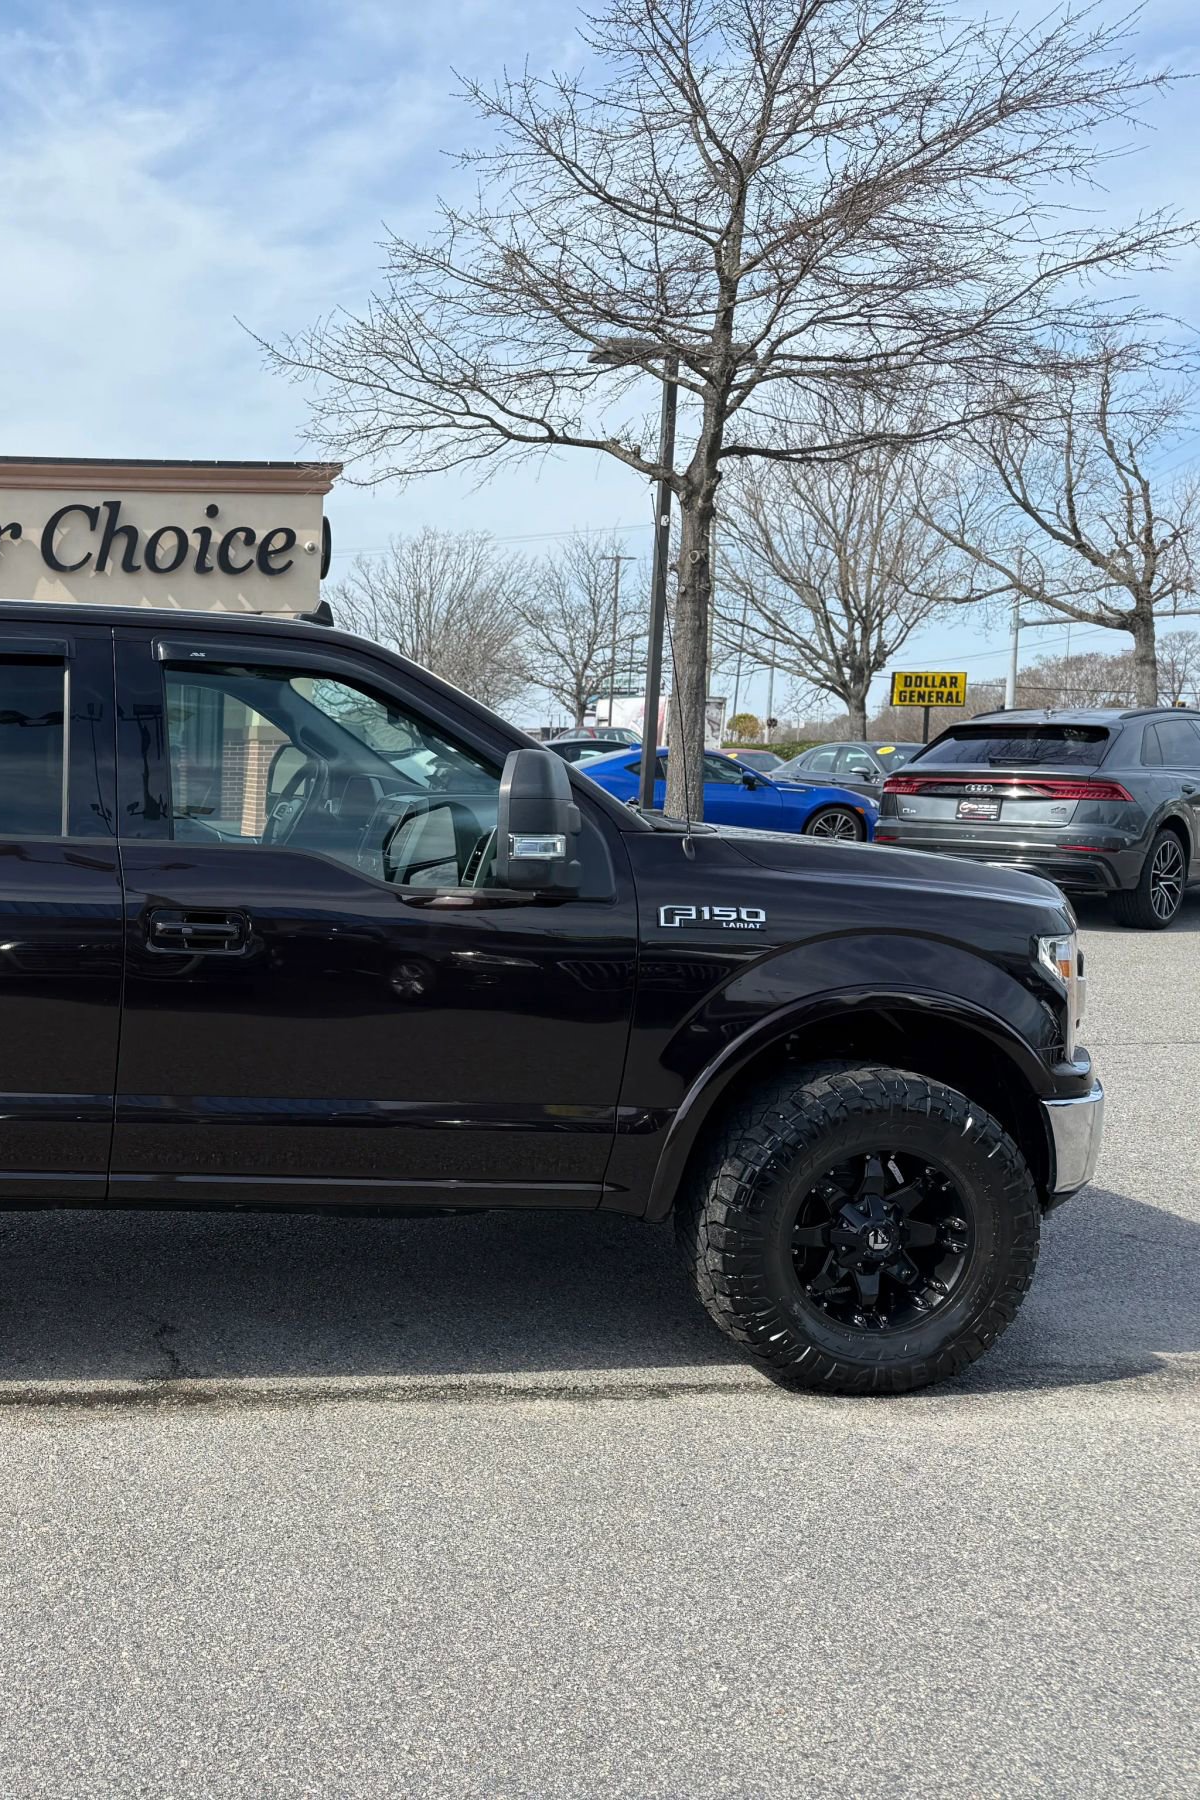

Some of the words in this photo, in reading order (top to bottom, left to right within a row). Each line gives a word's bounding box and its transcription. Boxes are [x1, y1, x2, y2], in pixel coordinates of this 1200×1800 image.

[41, 500, 297, 575] Choice
[904, 675, 958, 688] DOLLAR
[898, 690, 962, 703] GENERAL
[722, 921, 762, 929] LARIAT
